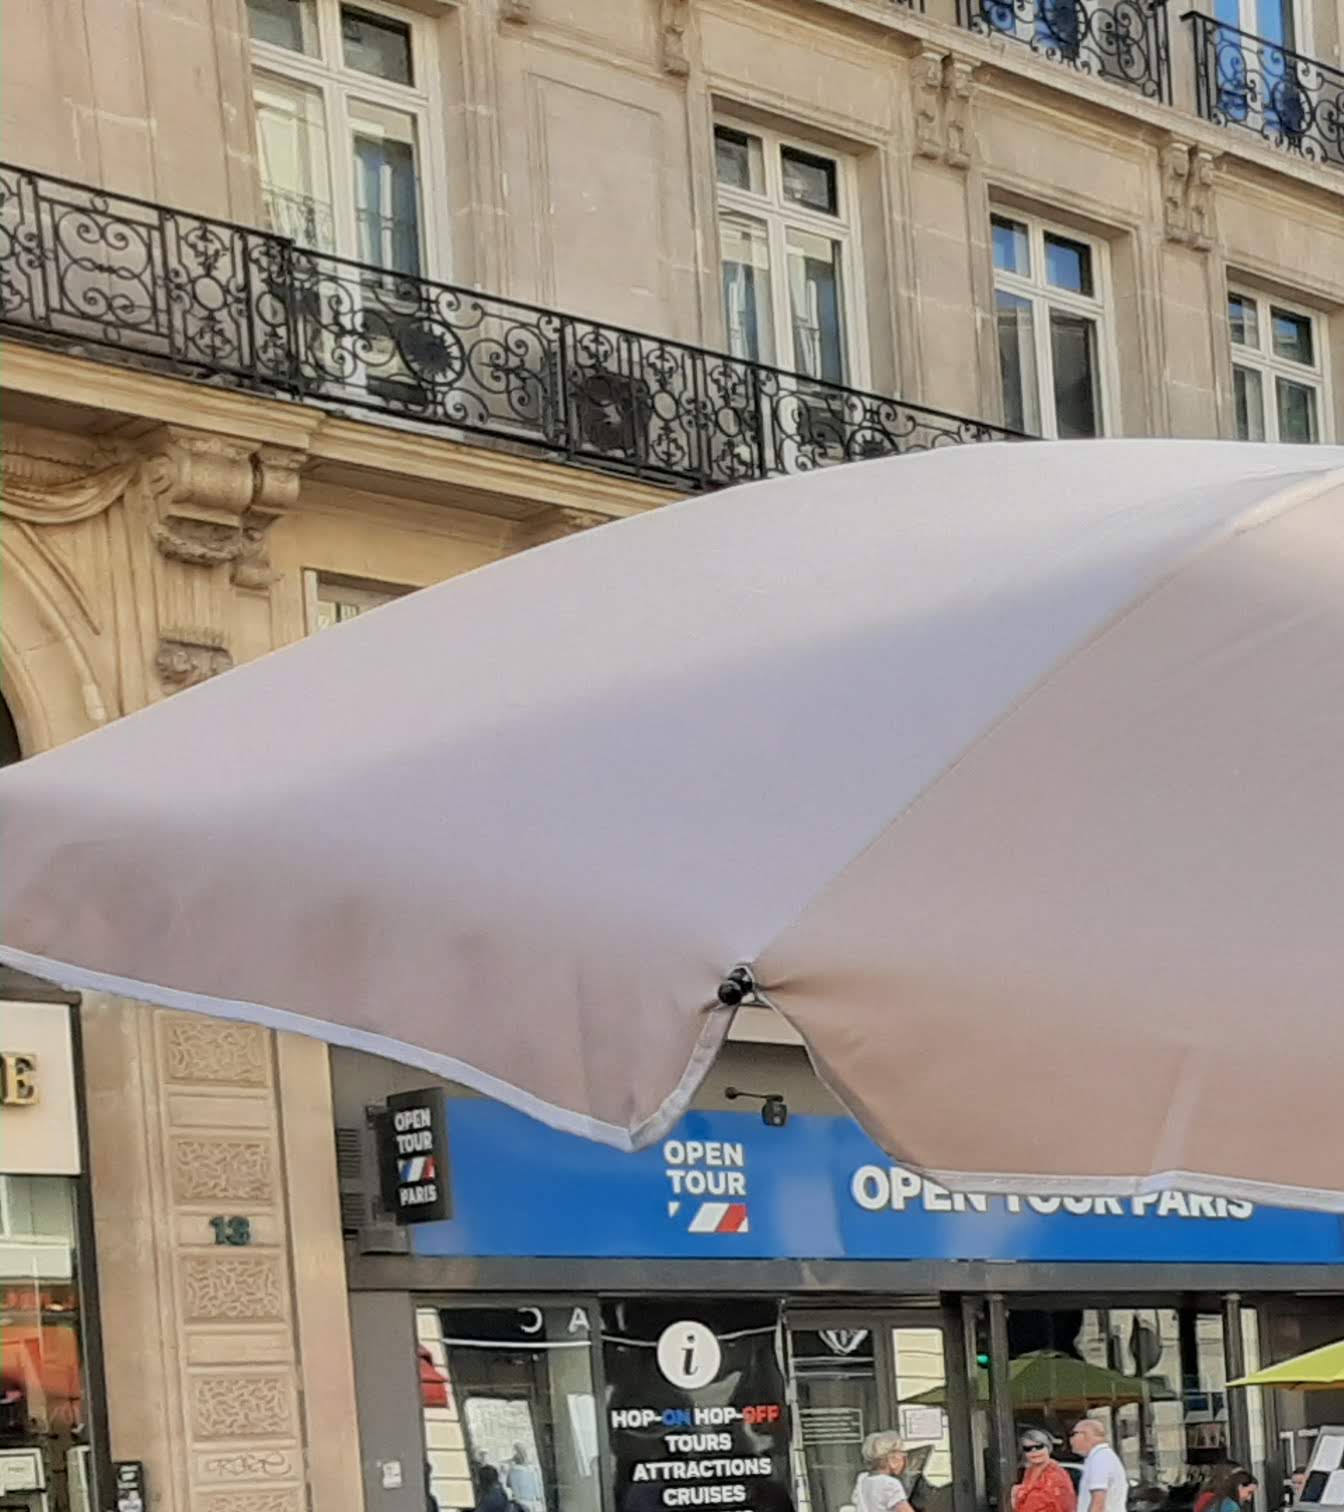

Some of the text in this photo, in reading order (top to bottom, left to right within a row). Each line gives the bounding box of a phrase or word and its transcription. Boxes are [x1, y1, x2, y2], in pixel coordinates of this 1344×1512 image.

[0, 1054, 39, 1106] E
[395, 1108, 431, 1132] OPEN
[396, 1130, 433, 1154] TOUR
[663, 1140, 744, 1168] OPEN
[665, 1169, 747, 1197] TOUR
[400, 1184, 437, 1207] PARIS
[209, 1215, 251, 1246] 13
[611, 1408, 692, 1429] HOP-ON
[694, 1404, 780, 1426] HOP-OFF
[665, 1433, 732, 1453] TOURS
[632, 1458, 772, 1482] ATTRACTIONS
[662, 1485, 747, 1507] CRUISES
